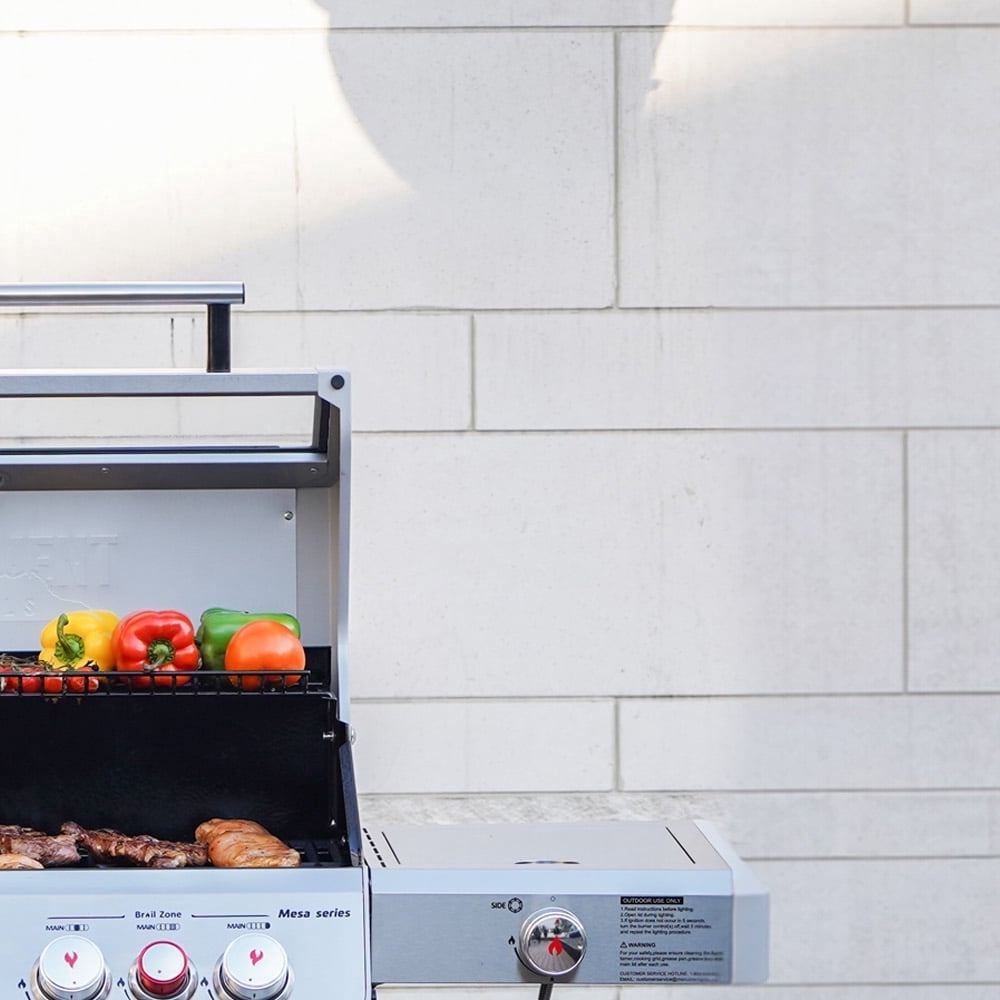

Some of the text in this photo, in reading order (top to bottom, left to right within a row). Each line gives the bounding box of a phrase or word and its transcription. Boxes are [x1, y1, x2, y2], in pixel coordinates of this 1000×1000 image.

[160, 910, 182, 918] Zone
[278, 908, 351, 918] Mesa series
